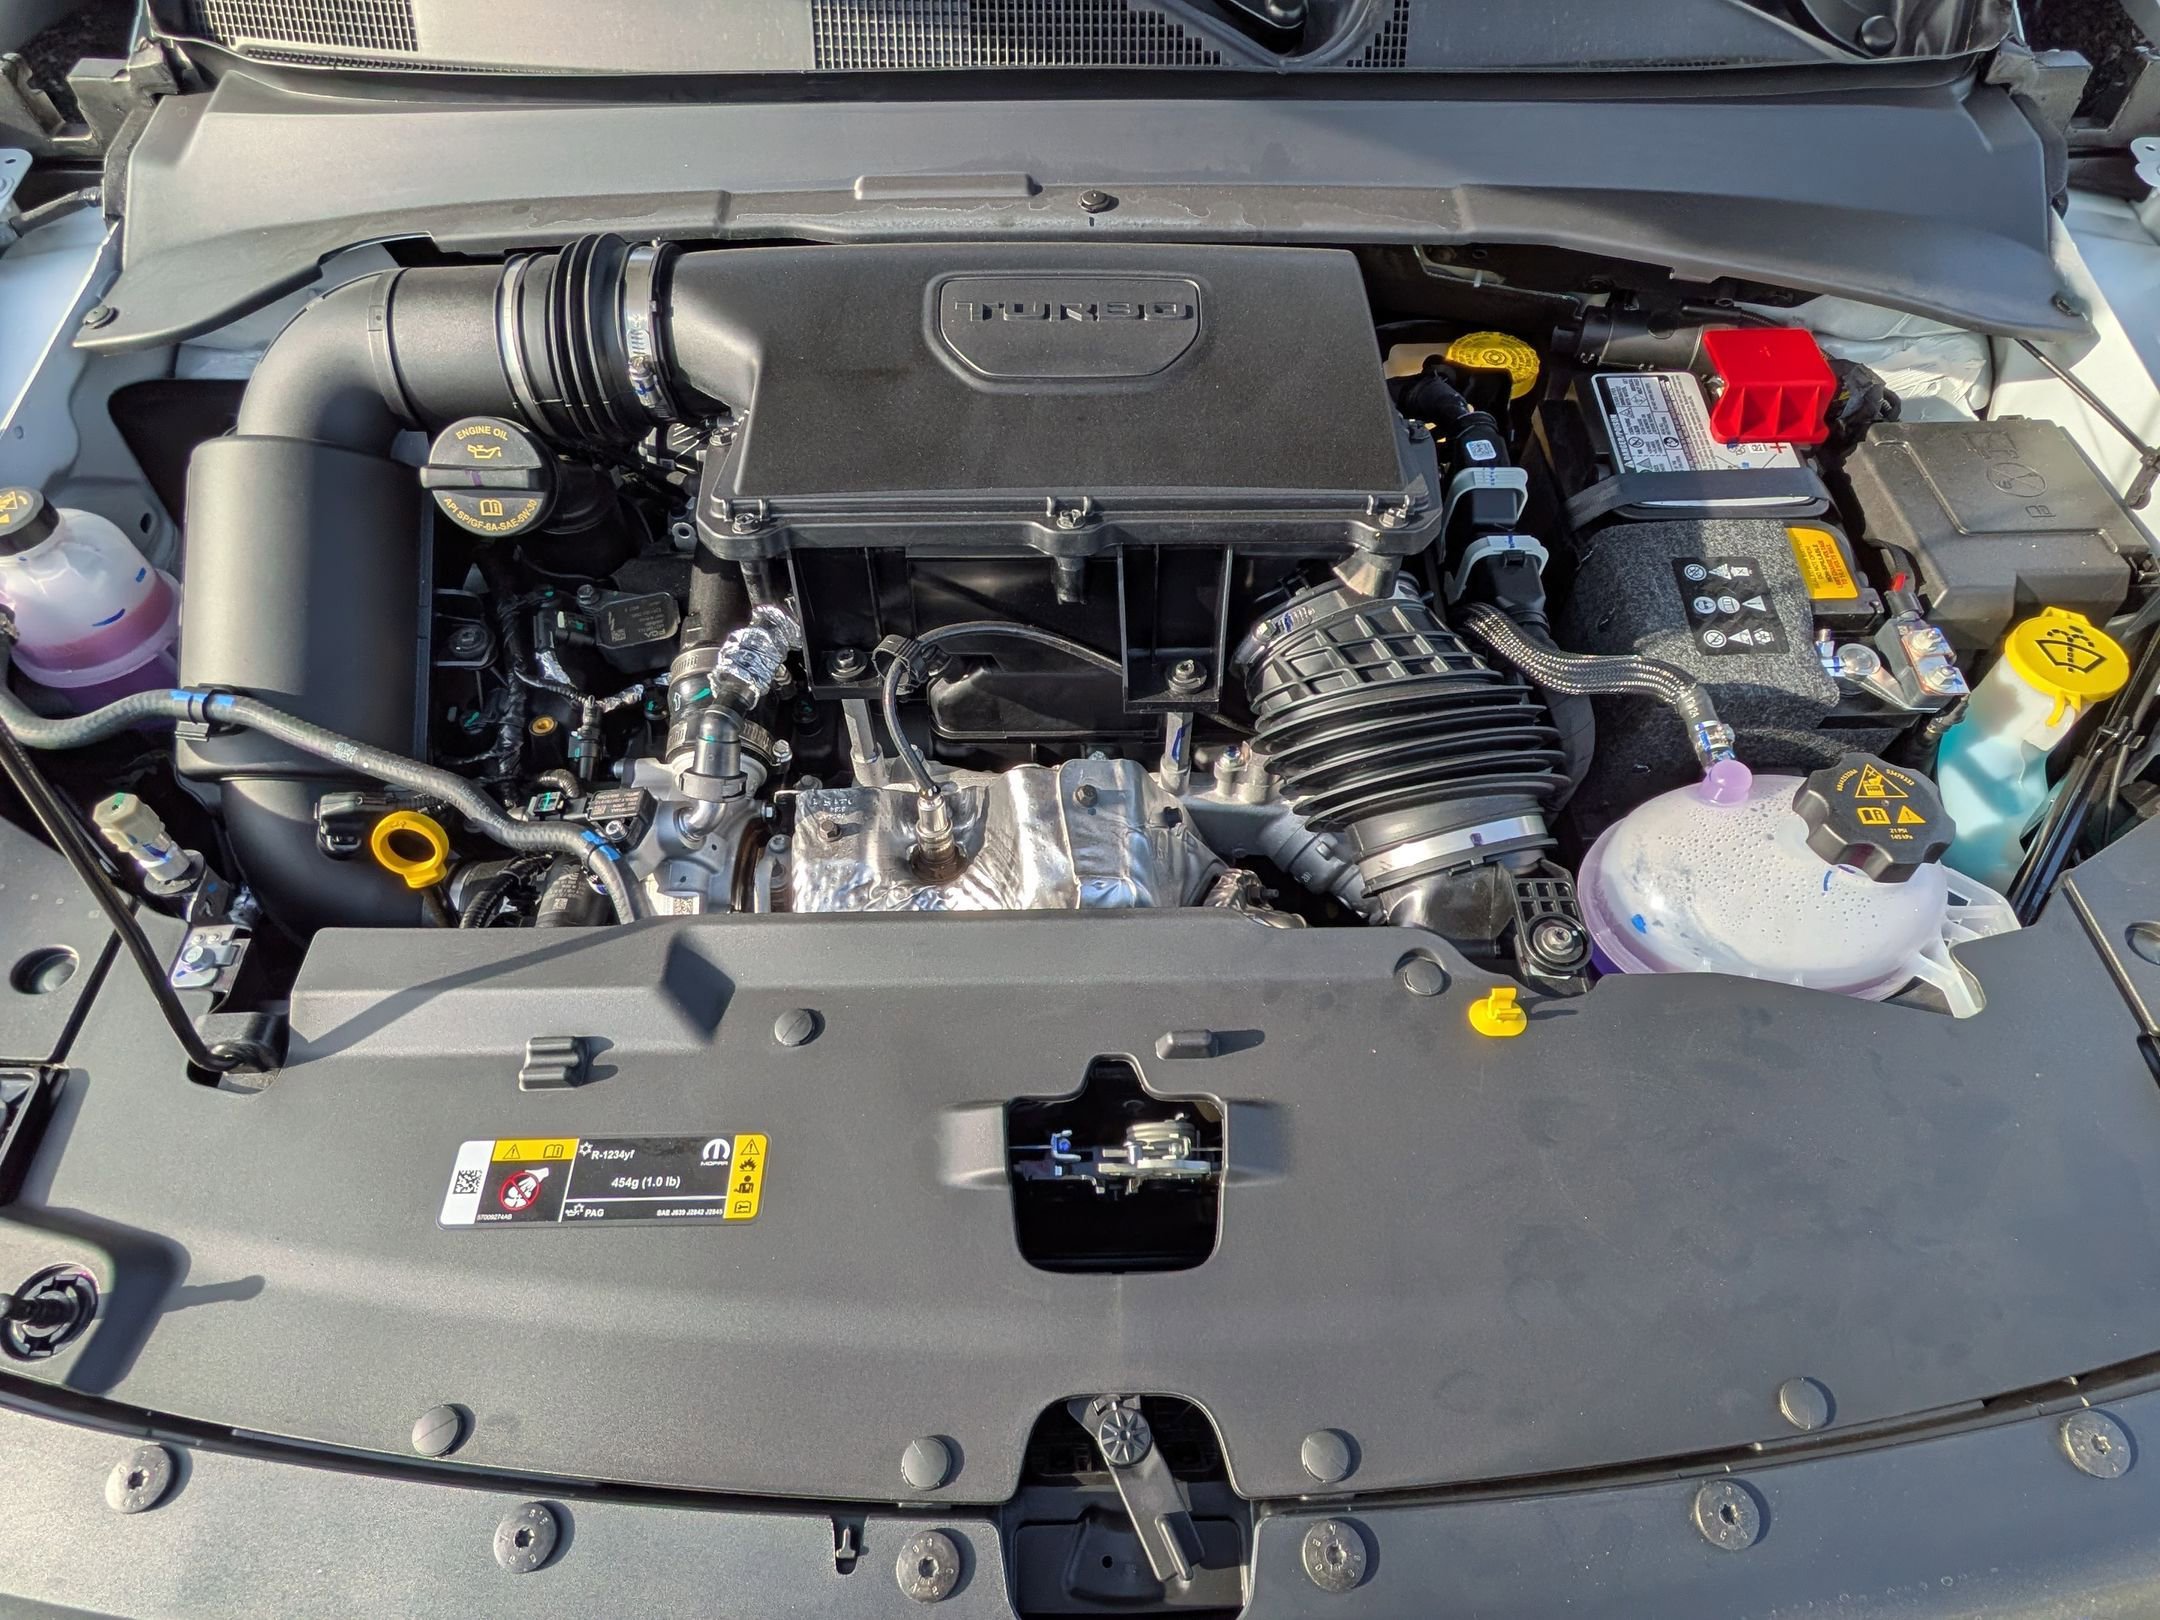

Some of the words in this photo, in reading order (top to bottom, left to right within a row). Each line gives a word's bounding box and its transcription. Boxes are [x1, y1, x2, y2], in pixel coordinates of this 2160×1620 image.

[954, 299, 1192, 322] TURBO
[455, 425, 491, 440] ENGINE
[493, 427, 509, 441] OIL
[443, 496, 459, 513] API
[591, 1149, 635, 1160] R-1234yf
[611, 1177, 639, 1190] 454g
[641, 1176, 663, 1189] (1.0
[665, 1176, 681, 1188] lb)
[584, 1208, 605, 1217] PAG
